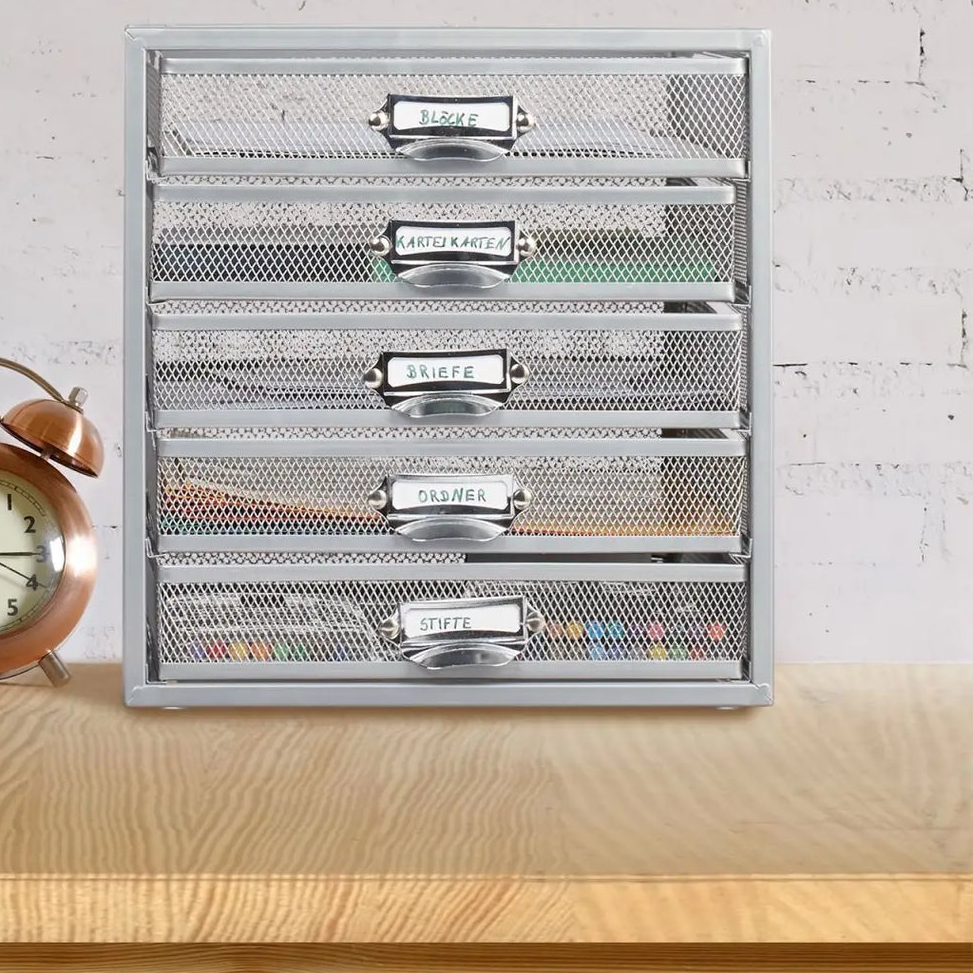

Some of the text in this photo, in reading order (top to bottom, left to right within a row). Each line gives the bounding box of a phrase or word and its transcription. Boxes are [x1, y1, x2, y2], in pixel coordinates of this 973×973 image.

[406, 364, 475, 379] BRIEFE
[7, 493, 12, 511] 1
[418, 487, 487, 503] ORDNER
[23, 515, 36, 534] 2
[35, 545, 47, 563] 3
[25, 574, 39, 591] 4
[7, 598, 19, 616] 5
[420, 617, 472, 632] STIFTE
